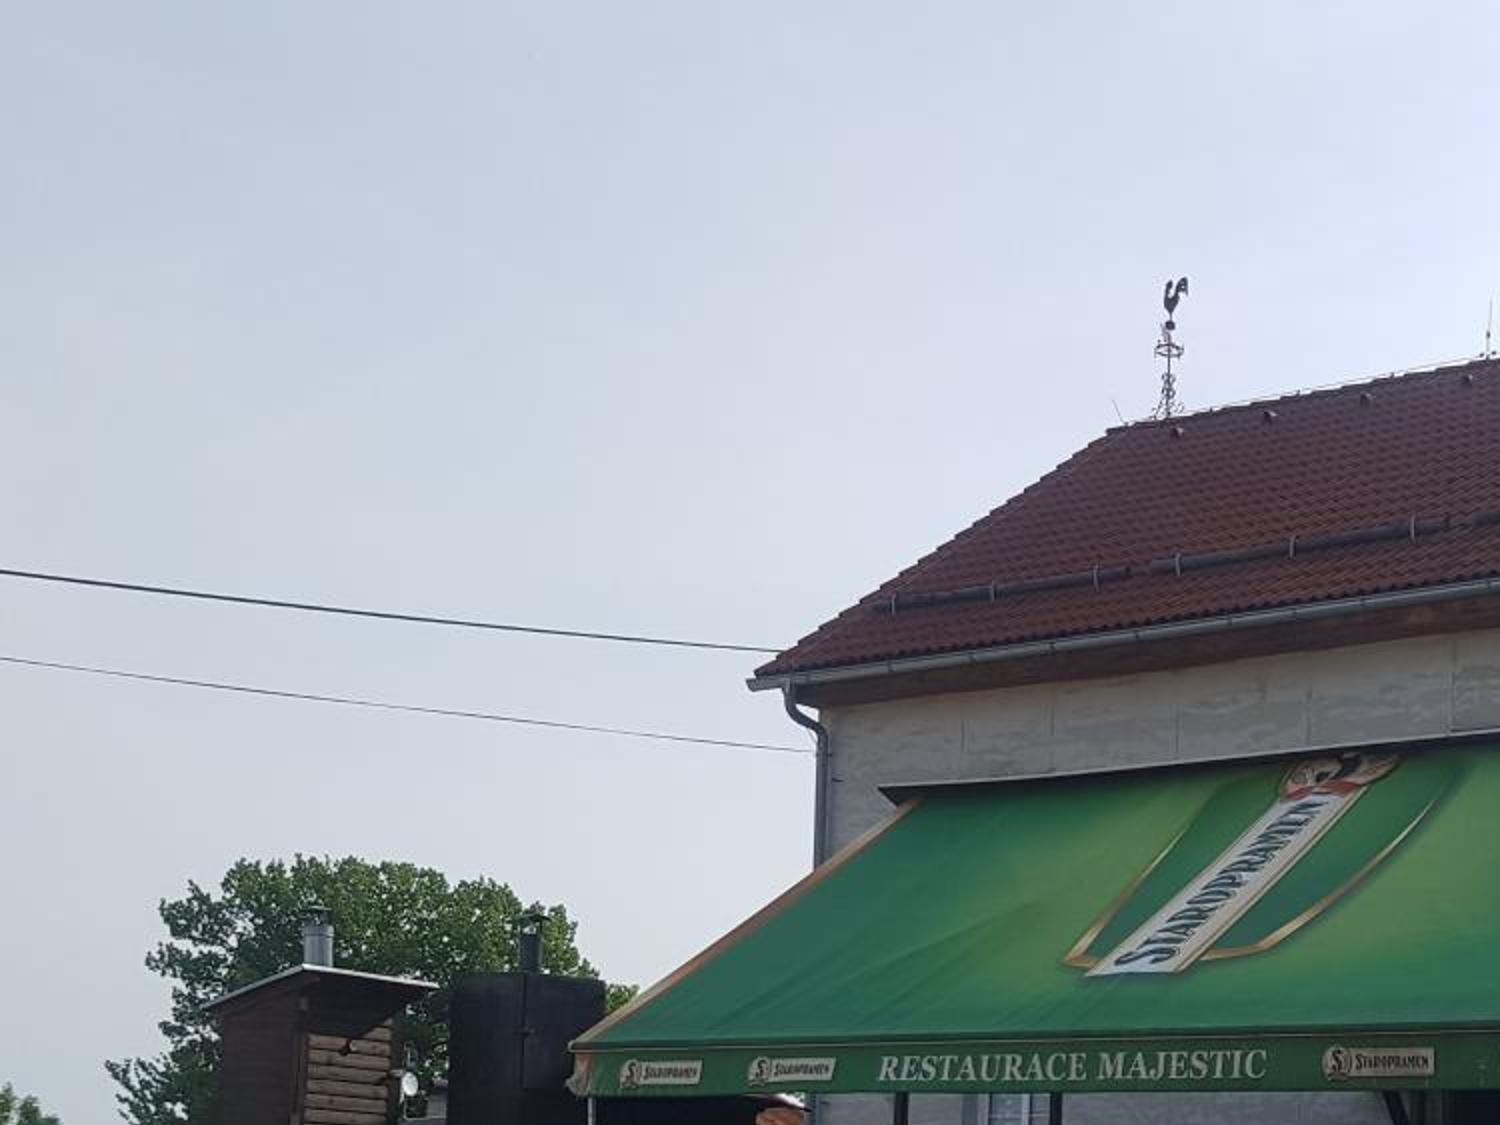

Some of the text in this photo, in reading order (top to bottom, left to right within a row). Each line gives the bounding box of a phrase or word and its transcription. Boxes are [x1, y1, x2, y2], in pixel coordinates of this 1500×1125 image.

[1113, 799, 1329, 966] STAROPRAMEN
[877, 1049, 1268, 1082] RESTAURACE MAJESTIC
[1355, 1053, 1430, 1071] STAROPRAMEN
